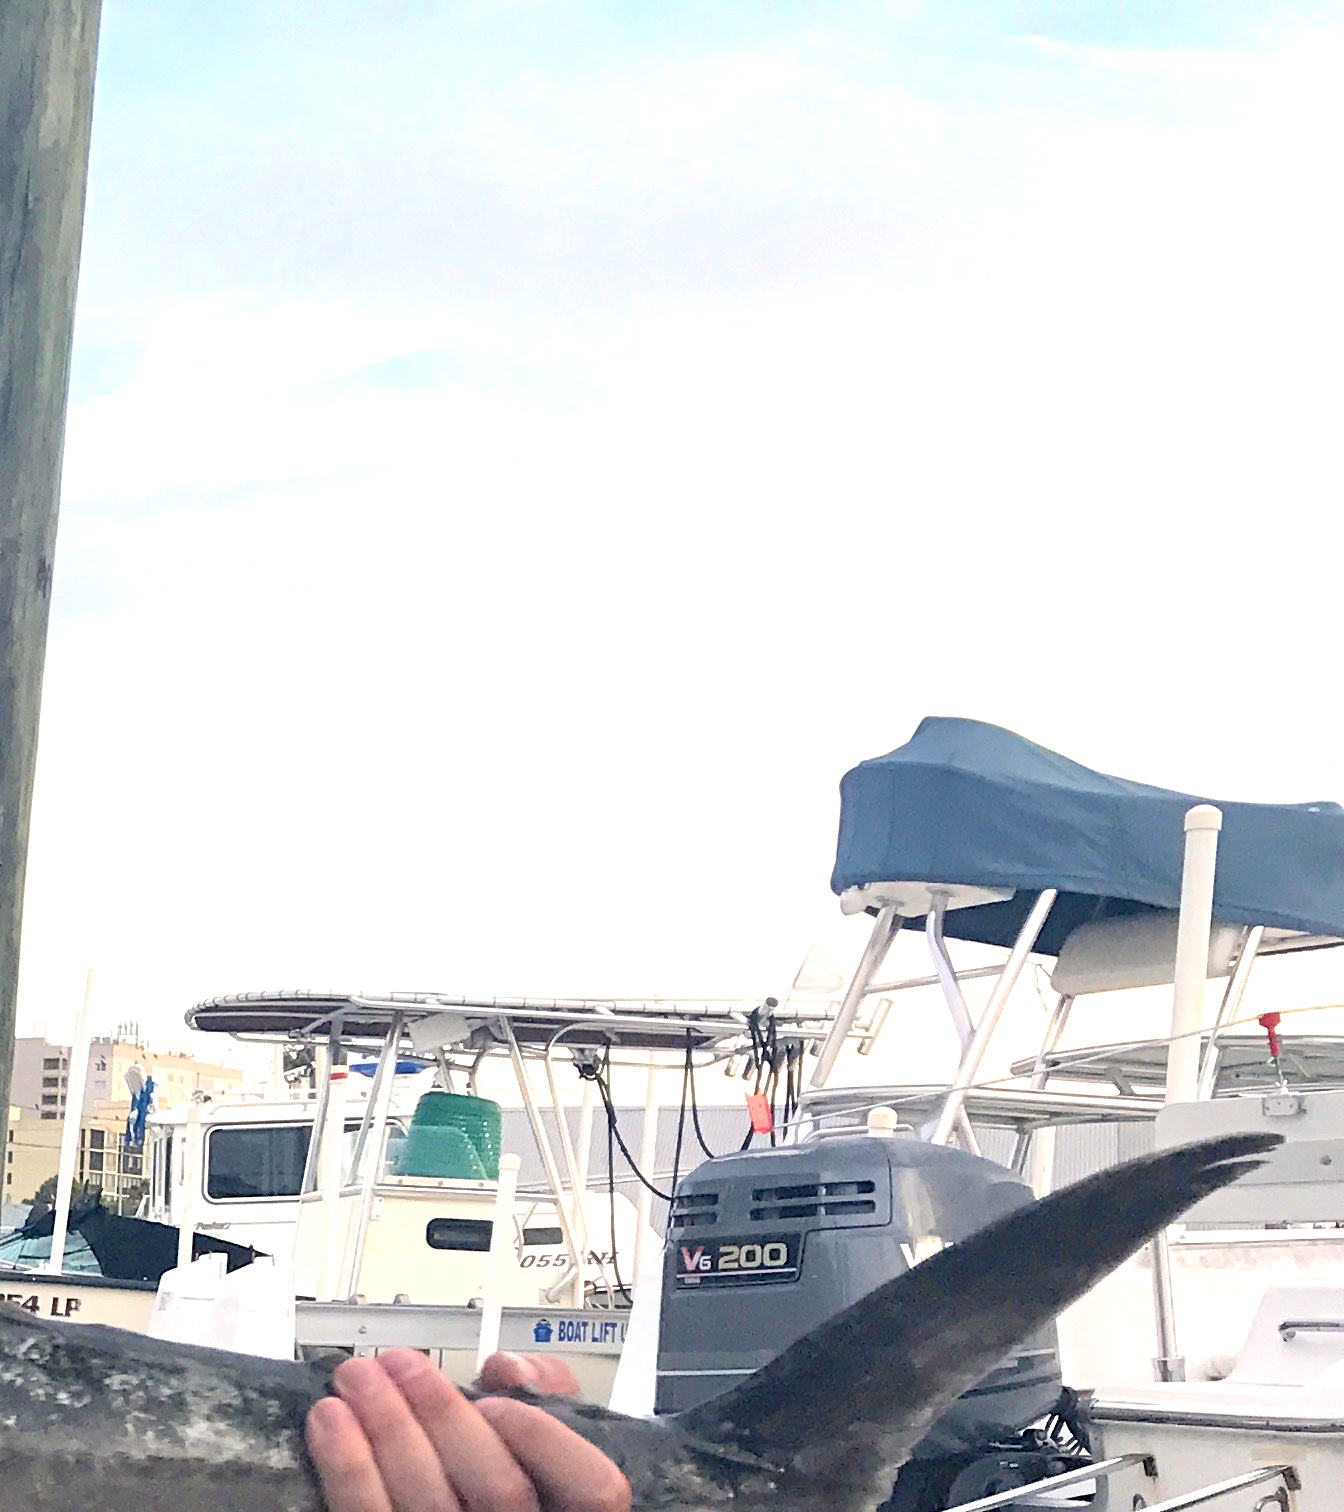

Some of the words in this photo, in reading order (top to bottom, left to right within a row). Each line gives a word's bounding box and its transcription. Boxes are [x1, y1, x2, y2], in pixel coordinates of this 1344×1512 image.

[718, 1242, 788, 1269] 200
[50, 1296, 81, 1317] LP
[557, 1320, 589, 1342] BOAT
[591, 1321, 618, 1344] LIFT
